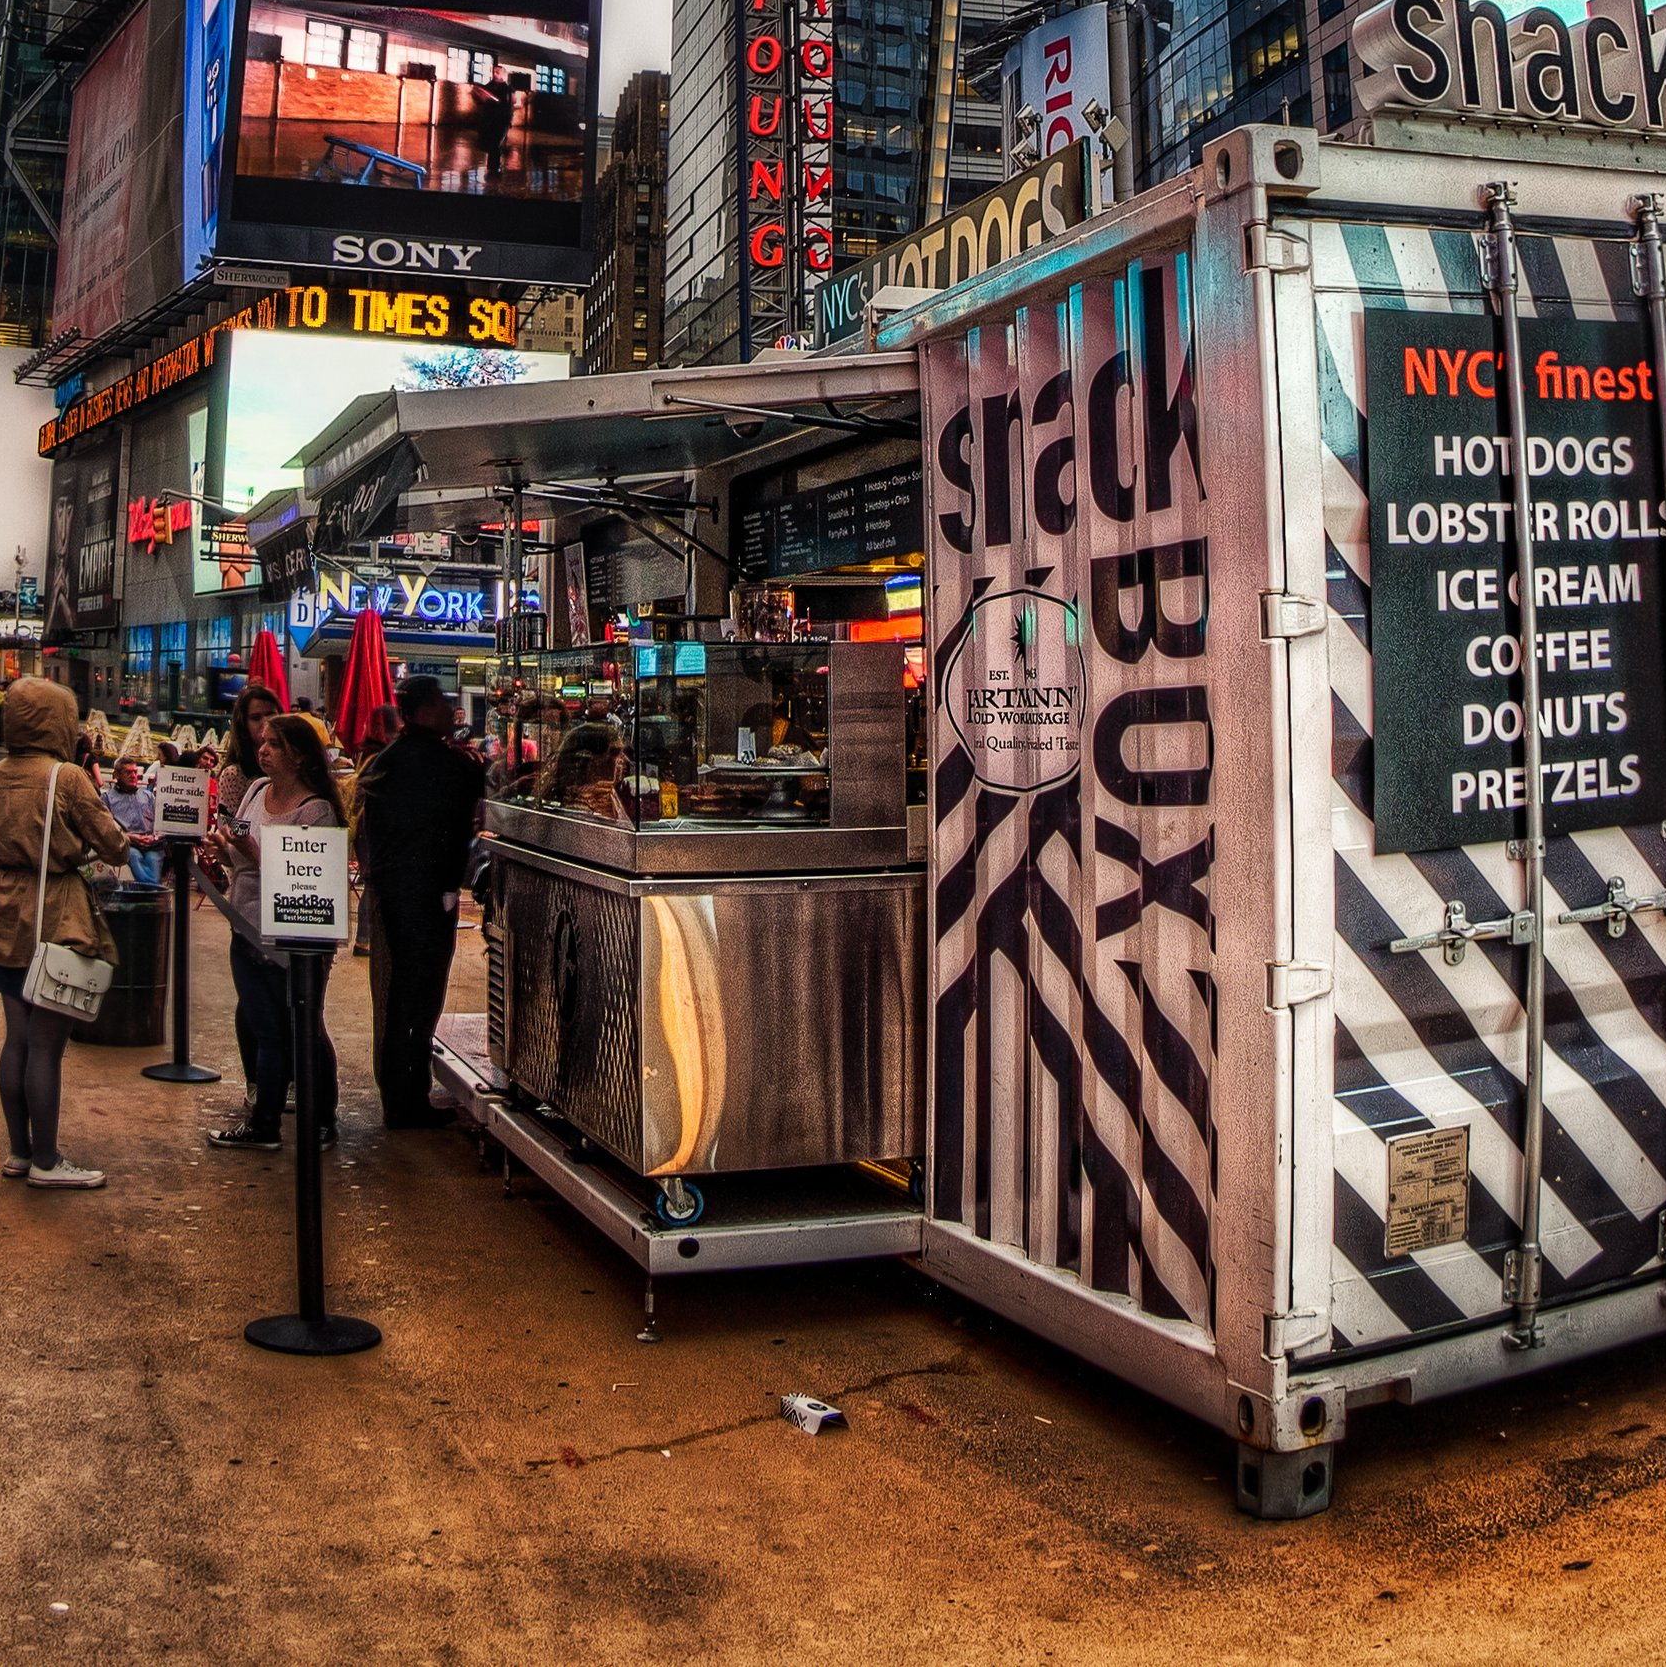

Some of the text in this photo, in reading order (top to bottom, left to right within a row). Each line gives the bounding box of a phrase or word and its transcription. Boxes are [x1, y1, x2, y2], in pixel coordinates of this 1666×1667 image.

[333, 236, 481, 271] SONY
[822, 163, 1067, 333] NYC's HOT DOGS
[217, 269, 287, 285] SHERWOOD
[86, 386, 113, 429] BUSINESS
[115, 375, 133, 414] NEWS
[135, 366, 149, 404] AND
[285, 286, 328, 328] TO
[349, 288, 450, 337] TIMES
[1404, 347, 1655, 402] NYC' finest
[937, 268, 1208, 554] snack
[1434, 436, 1634, 477] HOT DOGS
[397, 574, 484, 624] YORK
[1438, 569, 1499, 611] ICE
[989, 670, 1010, 681] EST.
[974, 712, 995, 725] OLD
[1090, 536, 1217, 954] BOX
[171, 772, 196, 784] Enter
[1451, 754, 1642, 814] PRETZELS
[160, 785, 205, 797] other side
[282, 836, 327, 854] Enter
[286, 861, 322, 877] here
[291, 882, 317, 892] please
[273, 892, 334, 907] SnackBox
[276, 907, 298, 916] Serving
[283, 914, 296, 922] Best
[309, 915, 324, 924] Dogs
